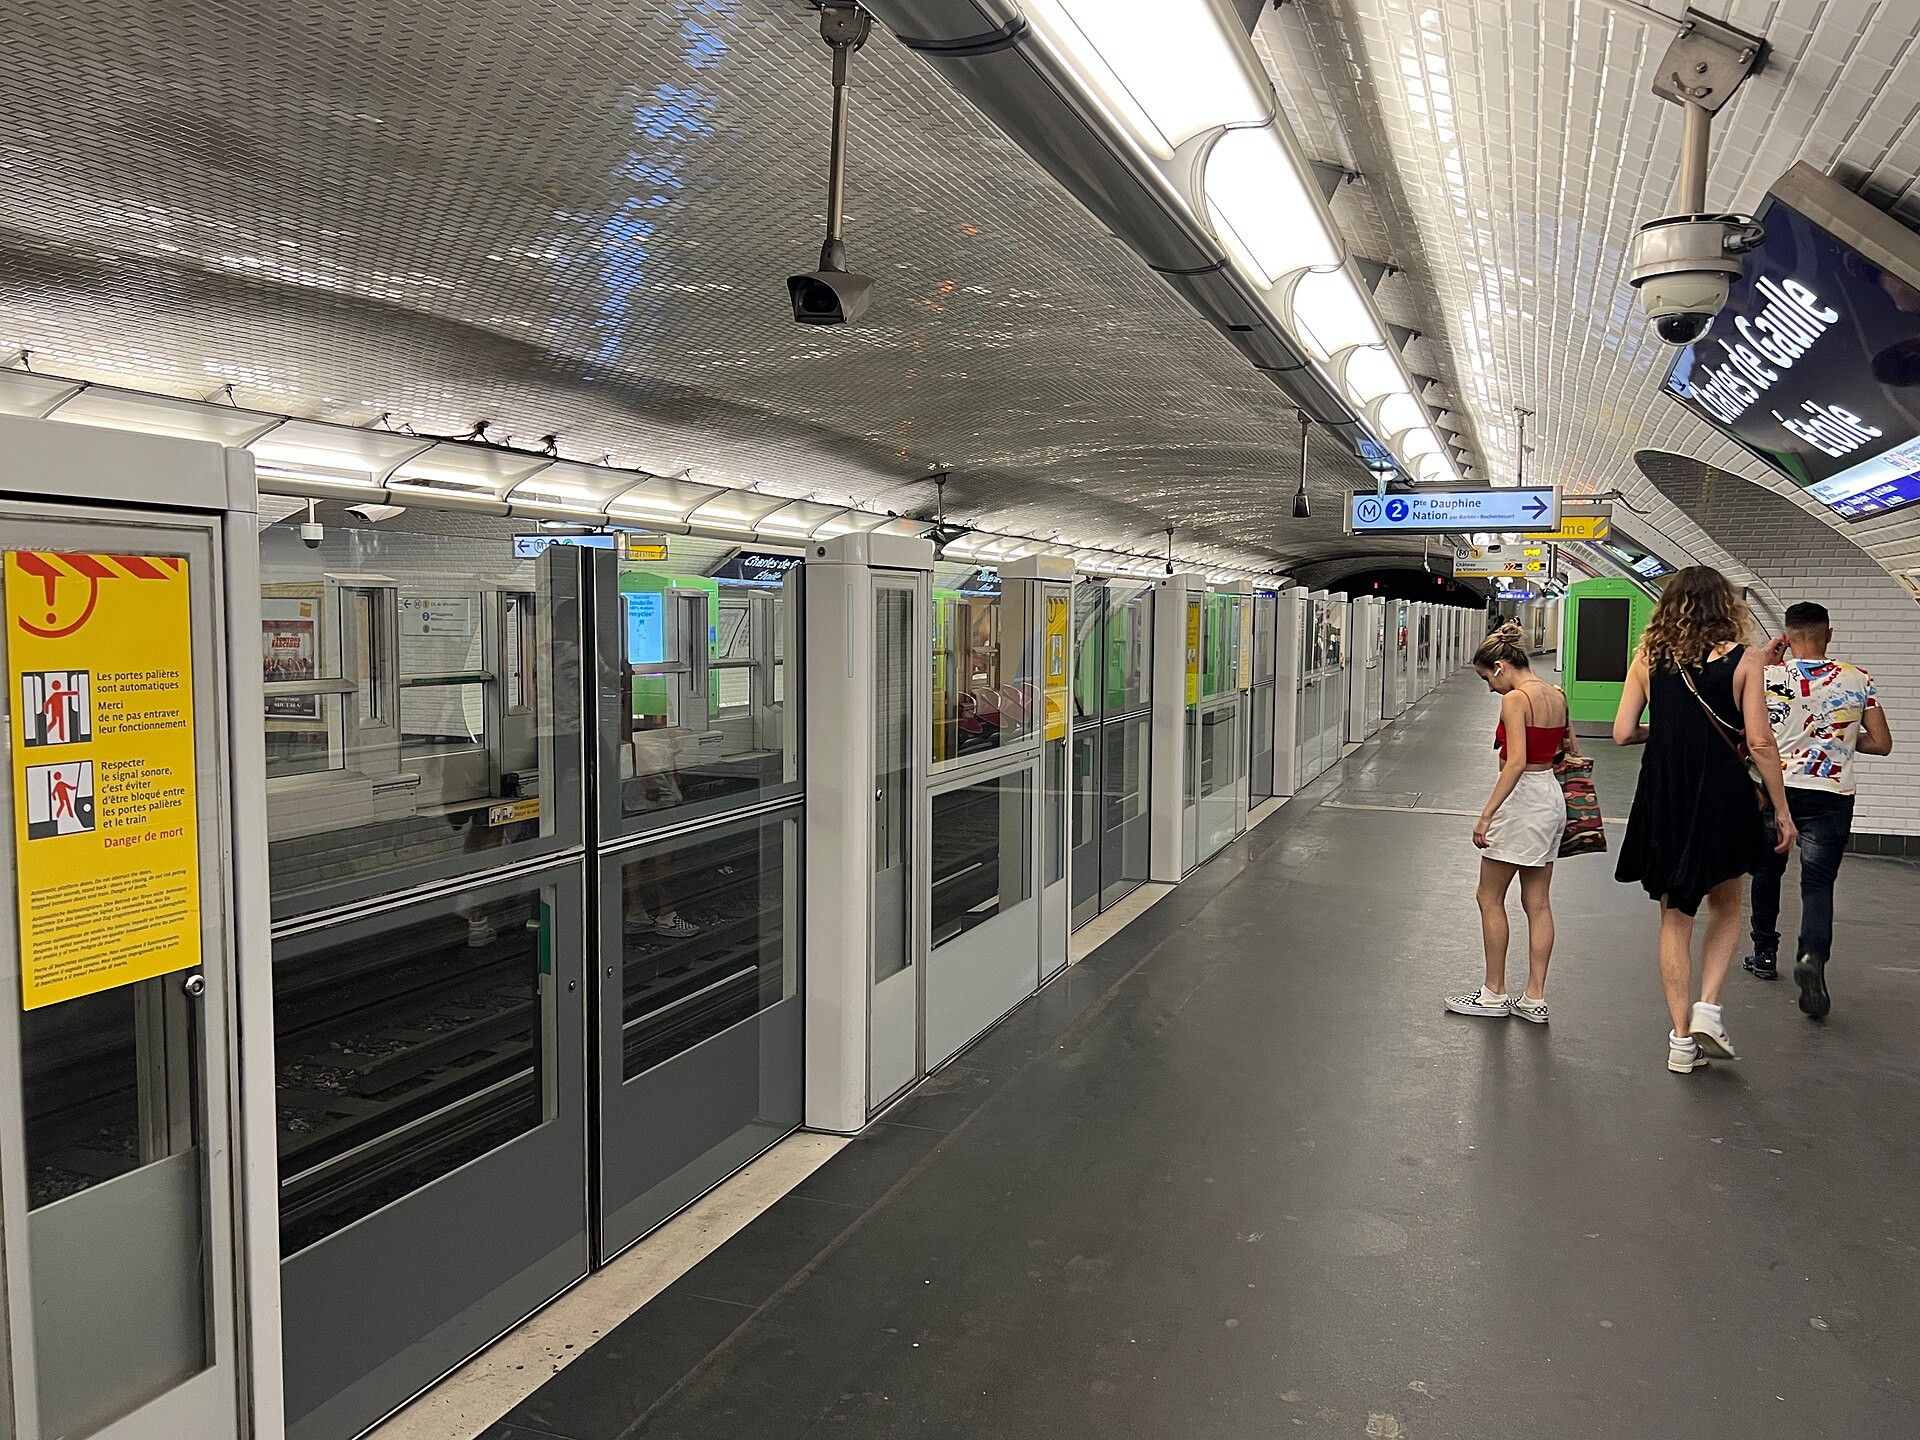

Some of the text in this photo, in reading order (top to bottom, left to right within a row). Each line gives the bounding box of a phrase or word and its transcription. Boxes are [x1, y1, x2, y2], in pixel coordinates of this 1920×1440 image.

[1688, 275, 1839, 425] Charles de Gaulle
[1771, 400, 1883, 458] Étoile
[1430, 499, 1481, 509] Dauphine
[1391, 503, 1402, 518] 2
[1412, 511, 1448, 520] Nation
[744, 556, 777, 568] Charles
[97, 670, 179, 682] Les portes palières
[97, 681, 179, 693] sont automatiques
[98, 700, 123, 710] Merci
[98, 714, 109, 722] de
[126, 712, 141, 722] pas
[144, 710, 179, 718] entraver
[99, 720, 186, 734] leur fonctionnement
[101, 759, 145, 770] Respecter
[102, 768, 172, 782] le signal sonore,
[102, 781, 151, 793] c'est éviter
[102, 788, 185, 805] d'être bloqué entre
[103, 799, 182, 817] les portes palières
[103, 815, 147, 828] et le train
[104, 827, 184, 848] Danger de mort
